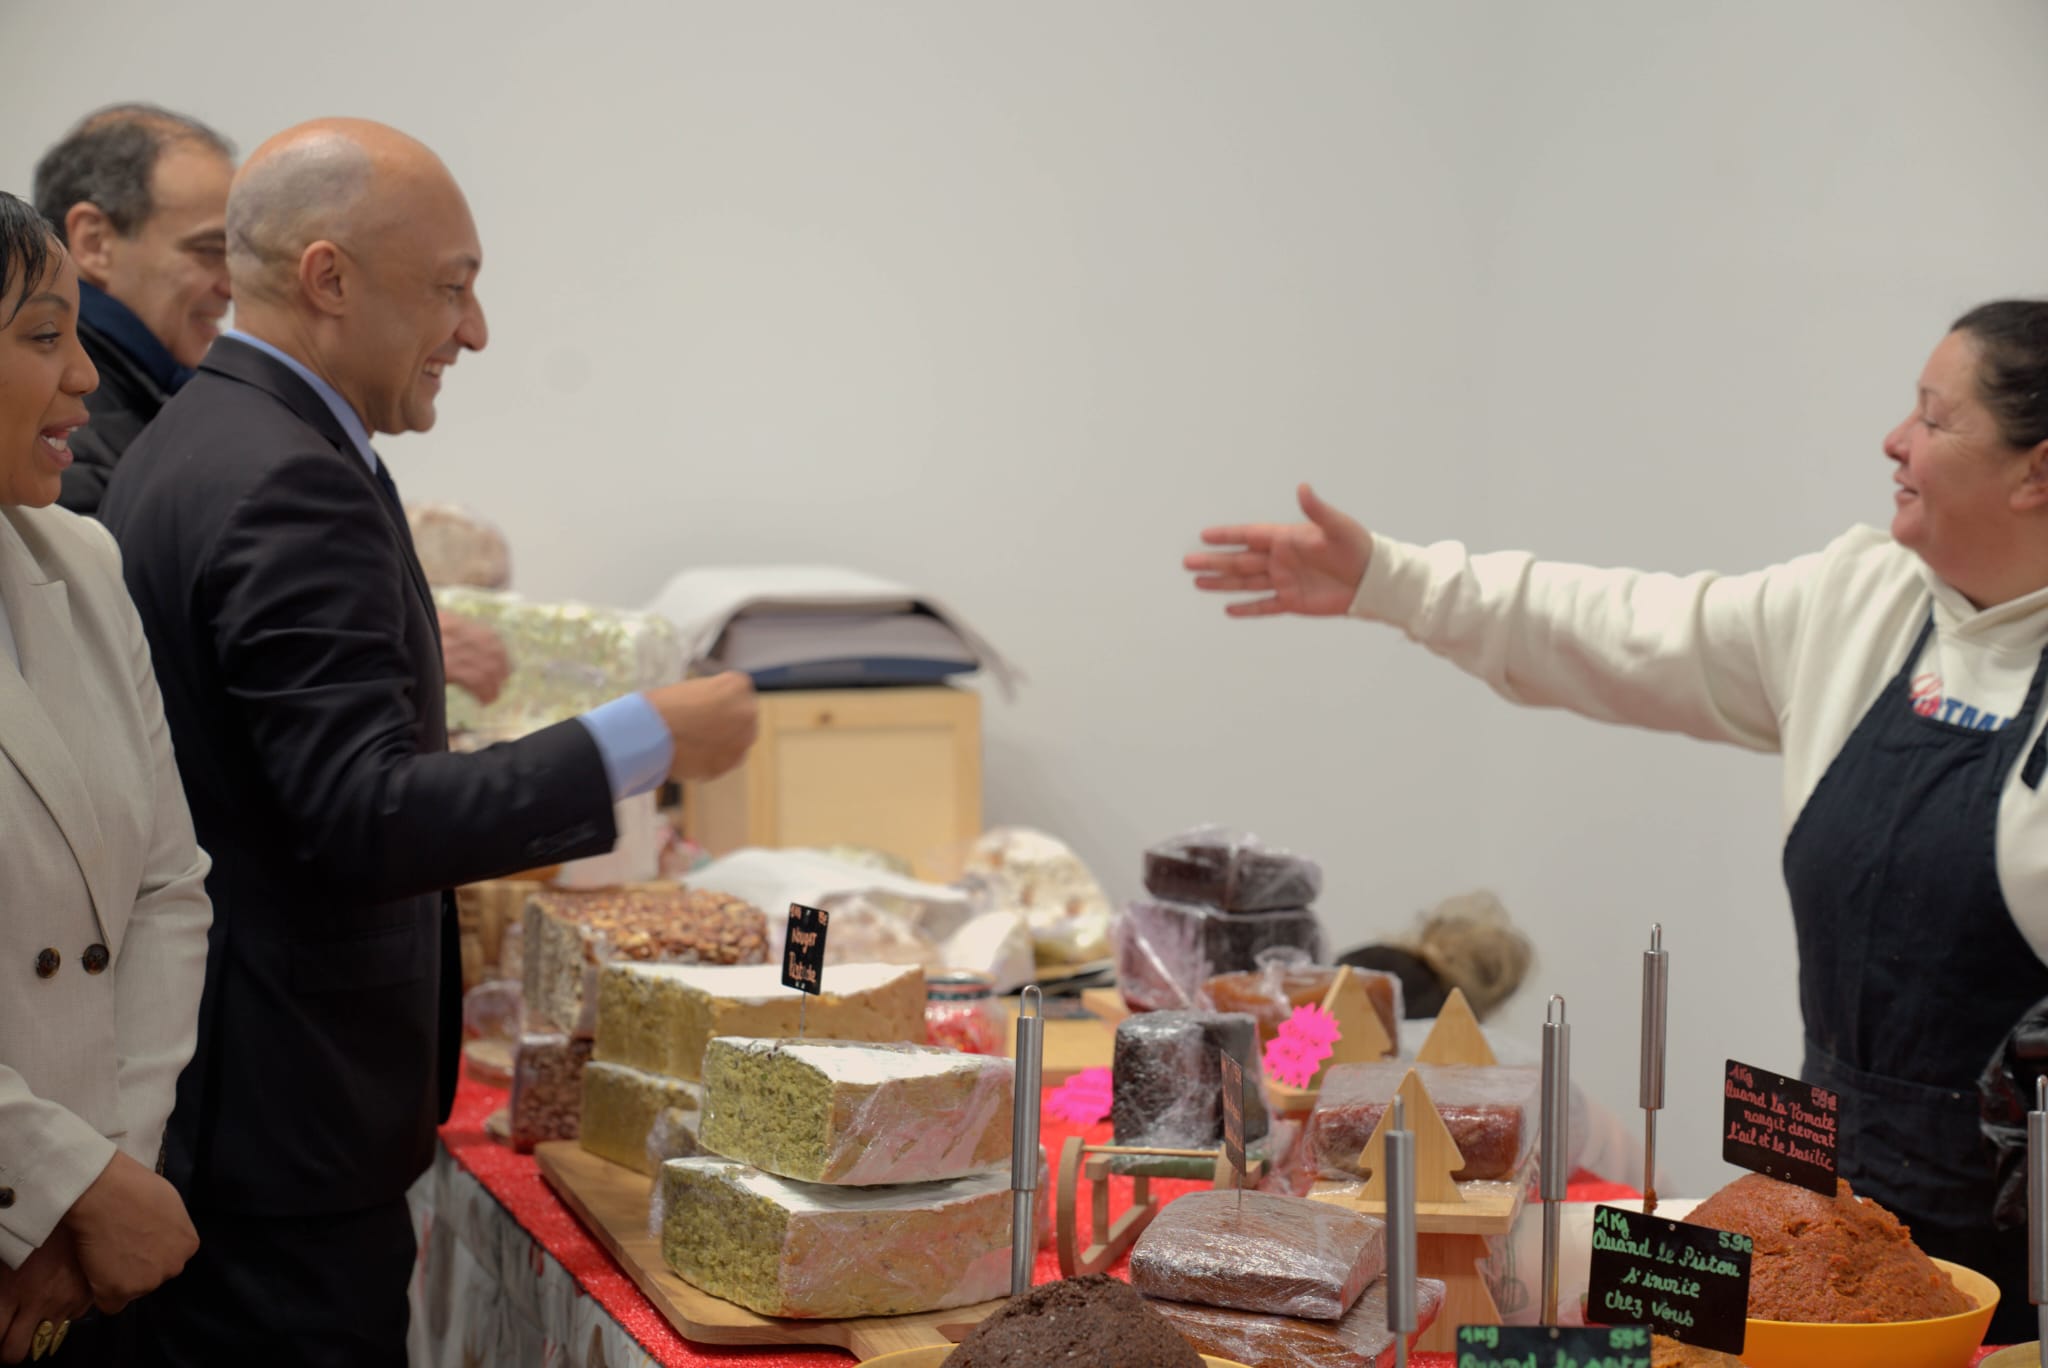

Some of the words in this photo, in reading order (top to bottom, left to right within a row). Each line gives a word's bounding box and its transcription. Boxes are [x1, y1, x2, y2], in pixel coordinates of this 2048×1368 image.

[1725, 1079, 1767, 1109] Quand
[1770, 1091, 1788, 1115] la
[1788, 1102, 1837, 1132] Tomate
[1758, 1132, 1771, 1148] et
[1771, 1135, 1785, 1154] le
[1786, 1141, 1834, 1172] basilic
[1788, 1122, 1835, 1148] devant
[1592, 1228, 1653, 1258] Quand
[1656, 1242, 1675, 1264] le
[1678, 1245, 1741, 1278] Pistou
